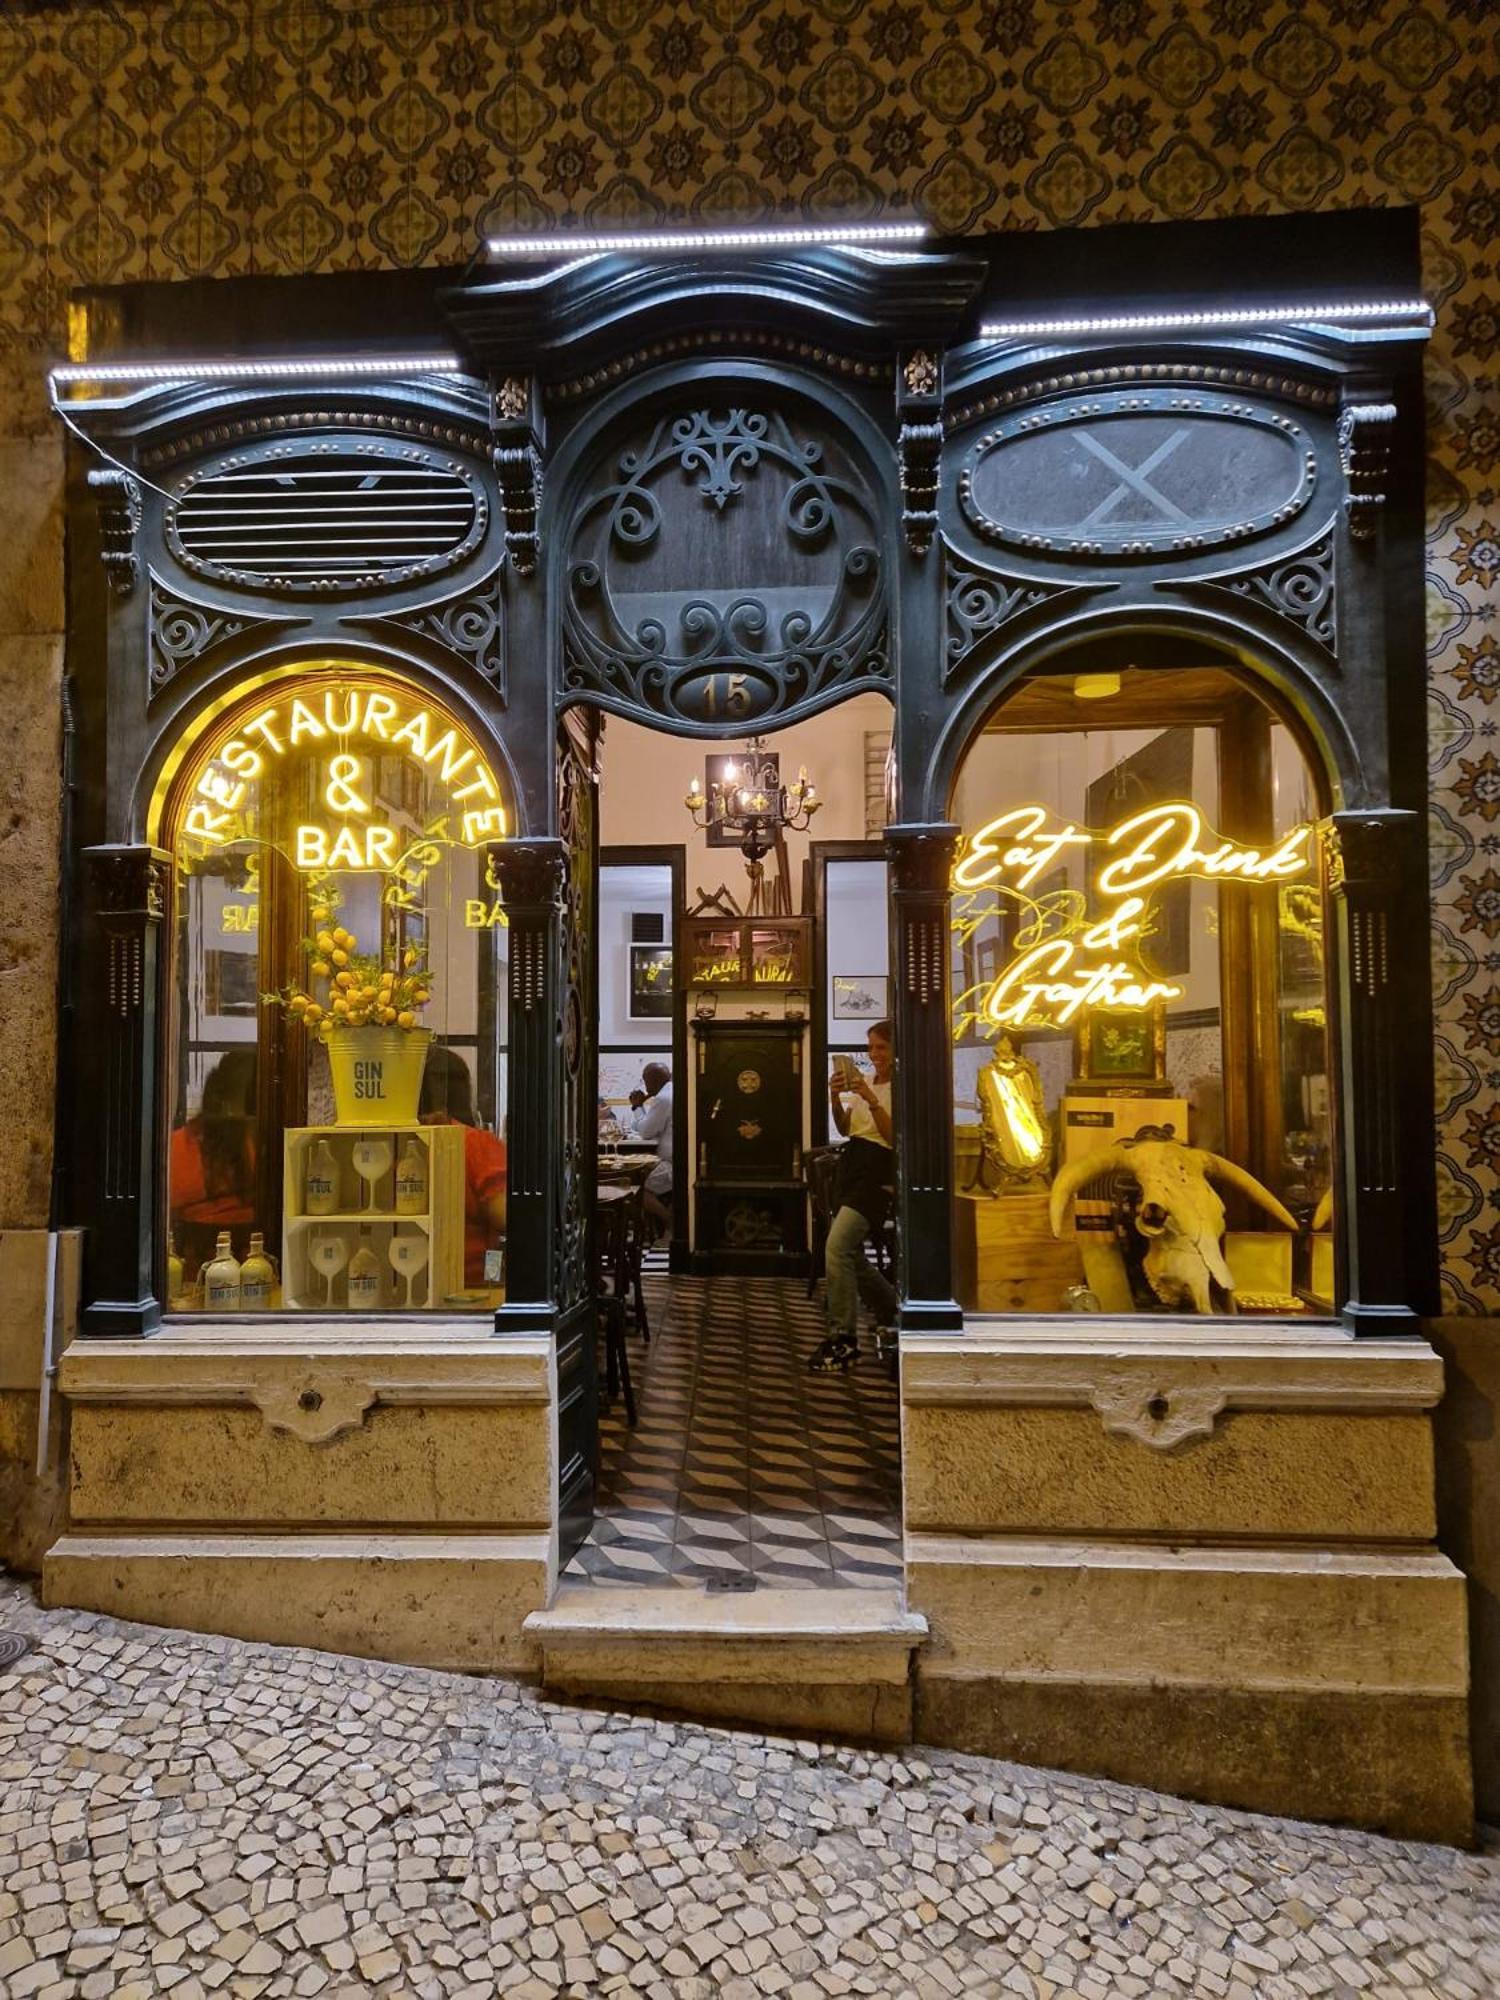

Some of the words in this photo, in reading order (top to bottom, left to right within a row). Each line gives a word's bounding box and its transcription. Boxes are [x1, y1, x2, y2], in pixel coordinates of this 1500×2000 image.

[703, 673, 751, 716] 15
[183, 690, 508, 843] RESTAURANTE
[325, 754, 371, 814] &
[296, 825, 395, 868] BAR
[954, 806, 1092, 890] Eat
[1099, 804, 1310, 894] Drink
[1083, 897, 1144, 951] &
[988, 940, 1181, 1024] Gather
[354, 1061, 383, 1080] GIN
[354, 1080, 386, 1099] SUL
